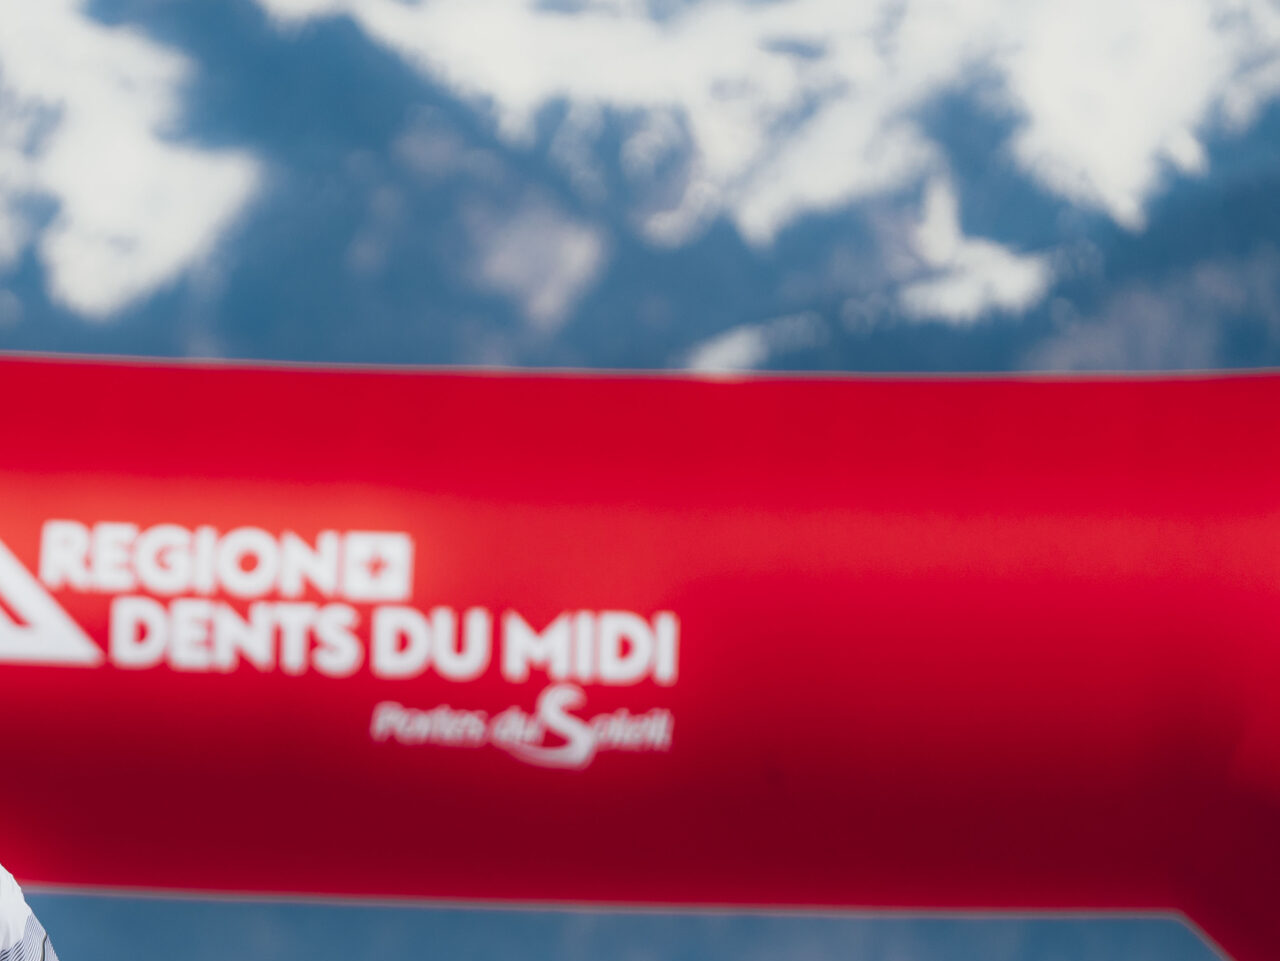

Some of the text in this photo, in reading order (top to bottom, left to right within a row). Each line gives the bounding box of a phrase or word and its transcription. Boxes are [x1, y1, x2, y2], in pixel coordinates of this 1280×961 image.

[41, 520, 340, 599] REGION
[110, 596, 678, 686] DENTS DU MIDI
